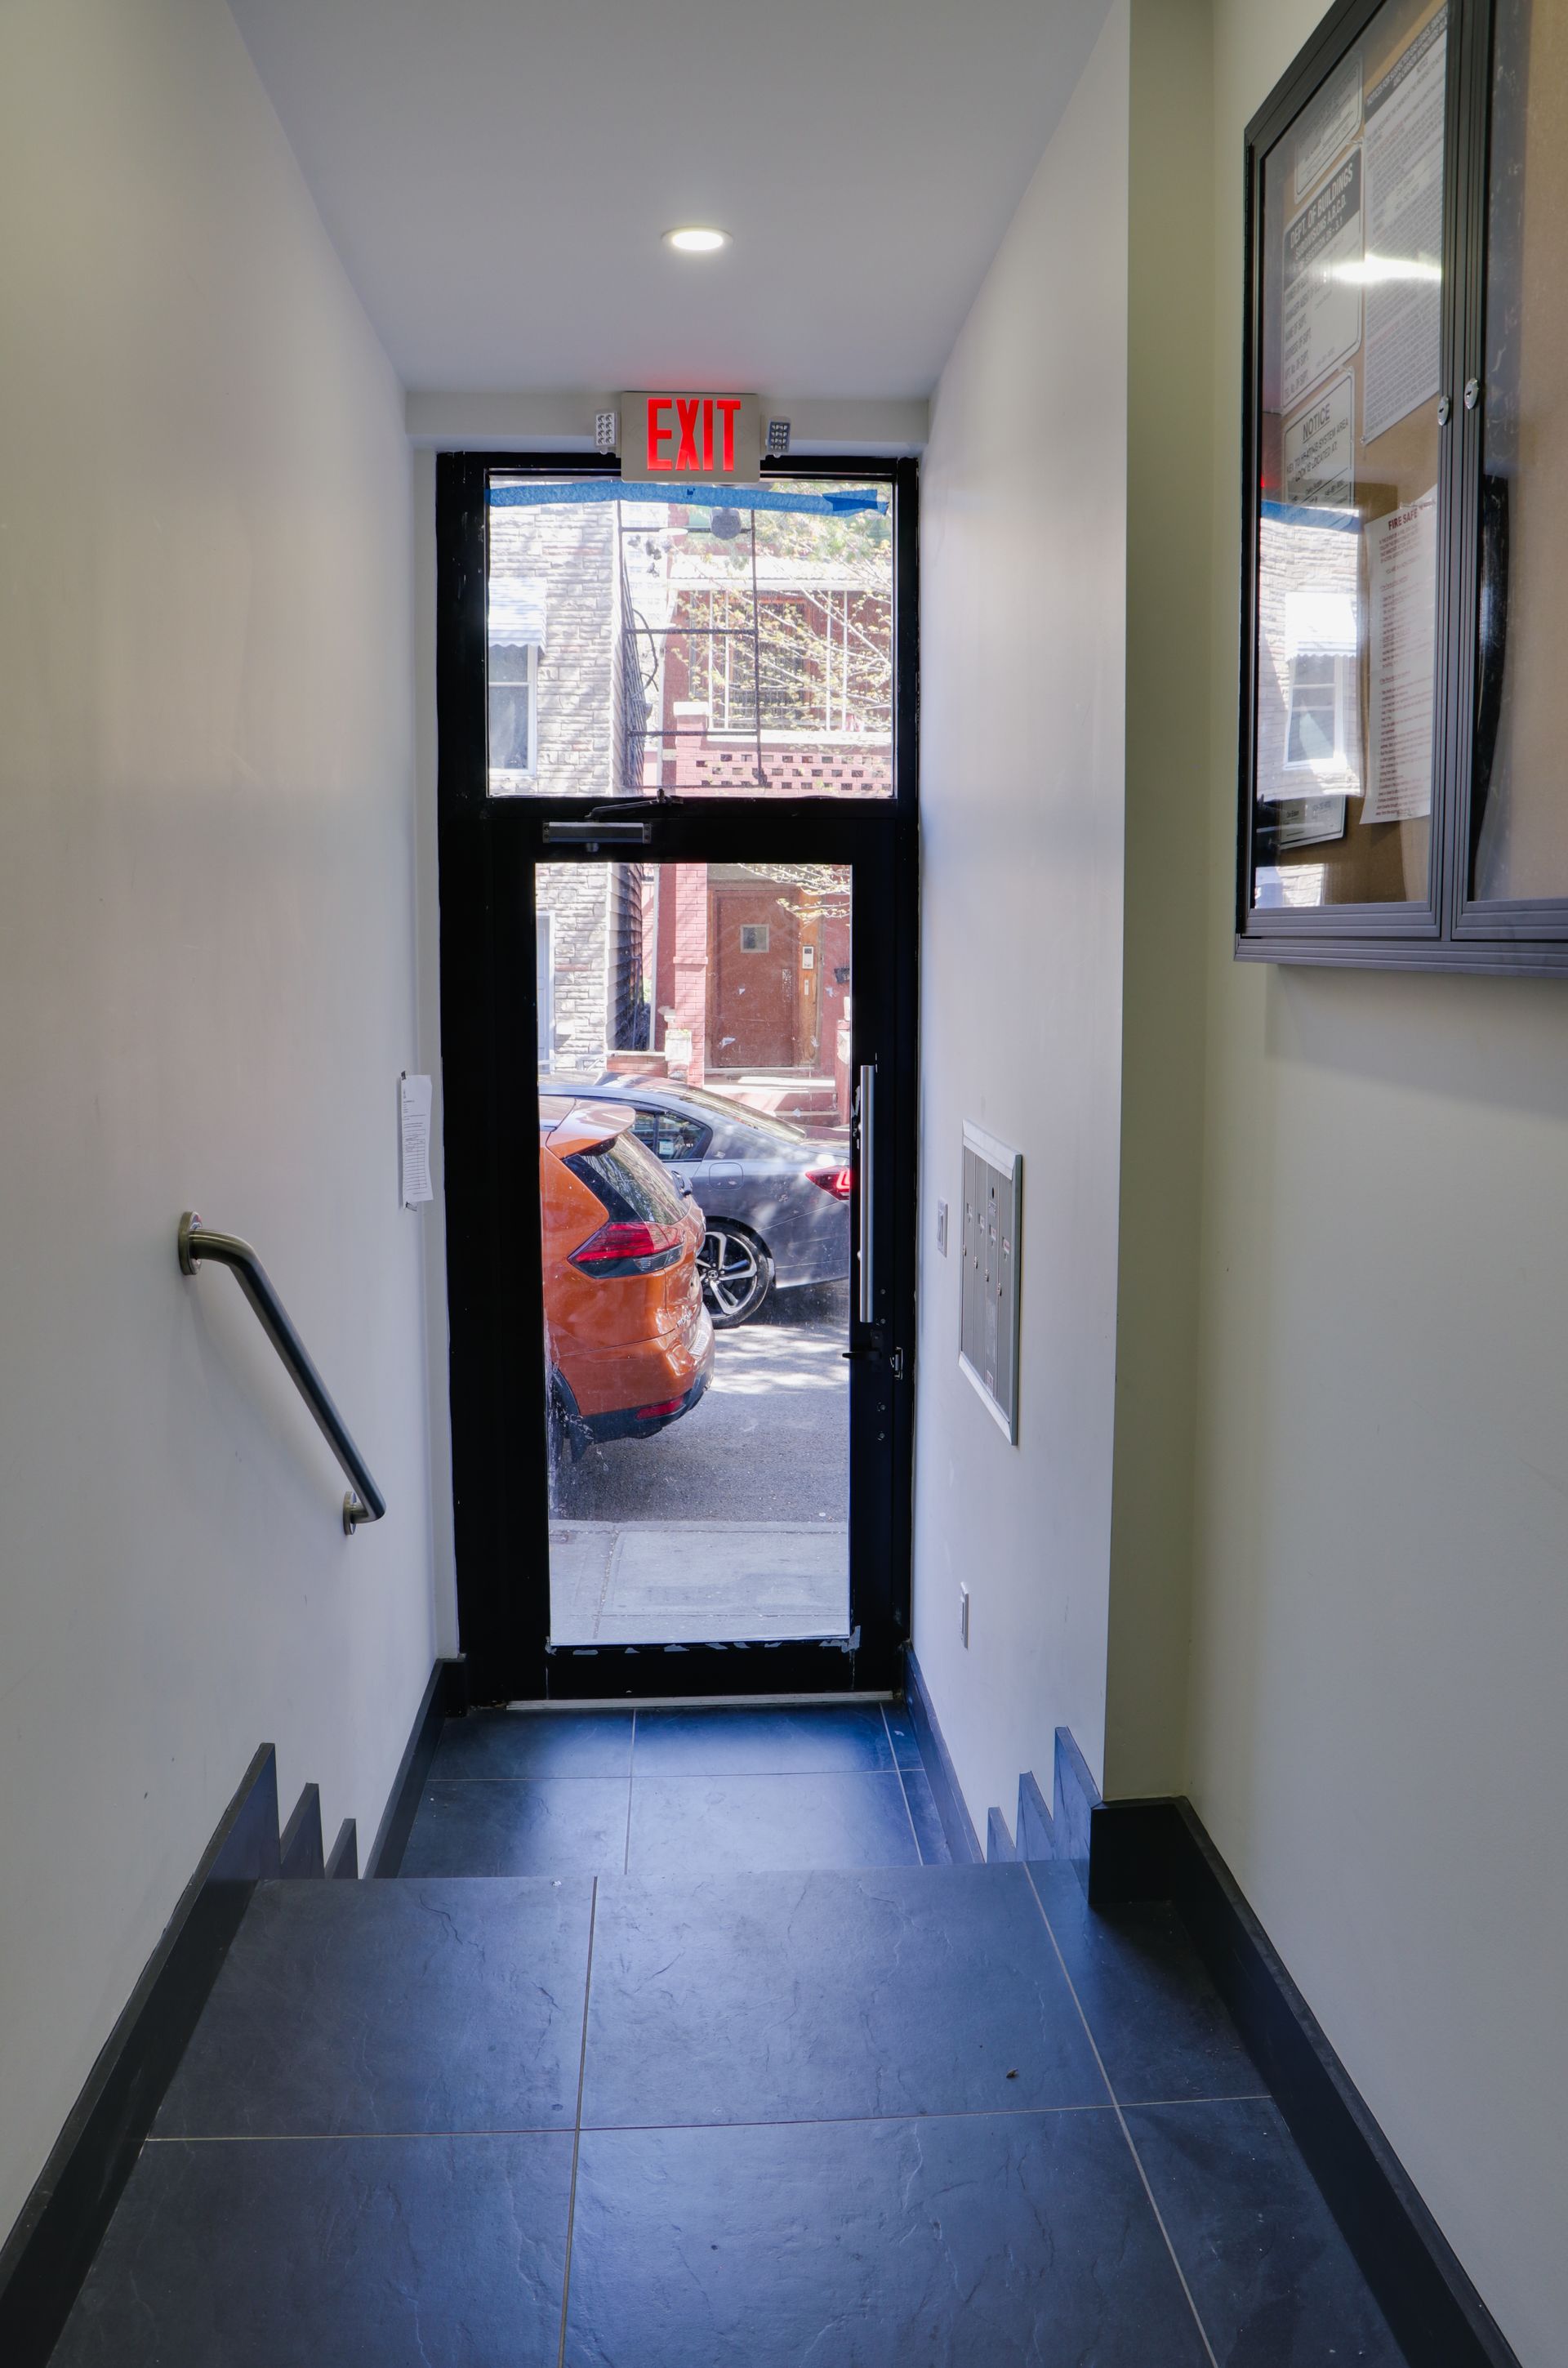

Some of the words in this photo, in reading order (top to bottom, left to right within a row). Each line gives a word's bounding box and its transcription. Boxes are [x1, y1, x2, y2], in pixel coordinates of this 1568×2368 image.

[1290, 217, 1307, 248] DEPT.
[1307, 205, 1316, 228] OF
[1317, 163, 1353, 217] BUILDINGS
[647, 398, 741, 471] EXIT
[1303, 403, 1330, 442] NOTICE
[1388, 516, 1402, 531] FIRE
[1402, 508, 1418, 524] SAFE
